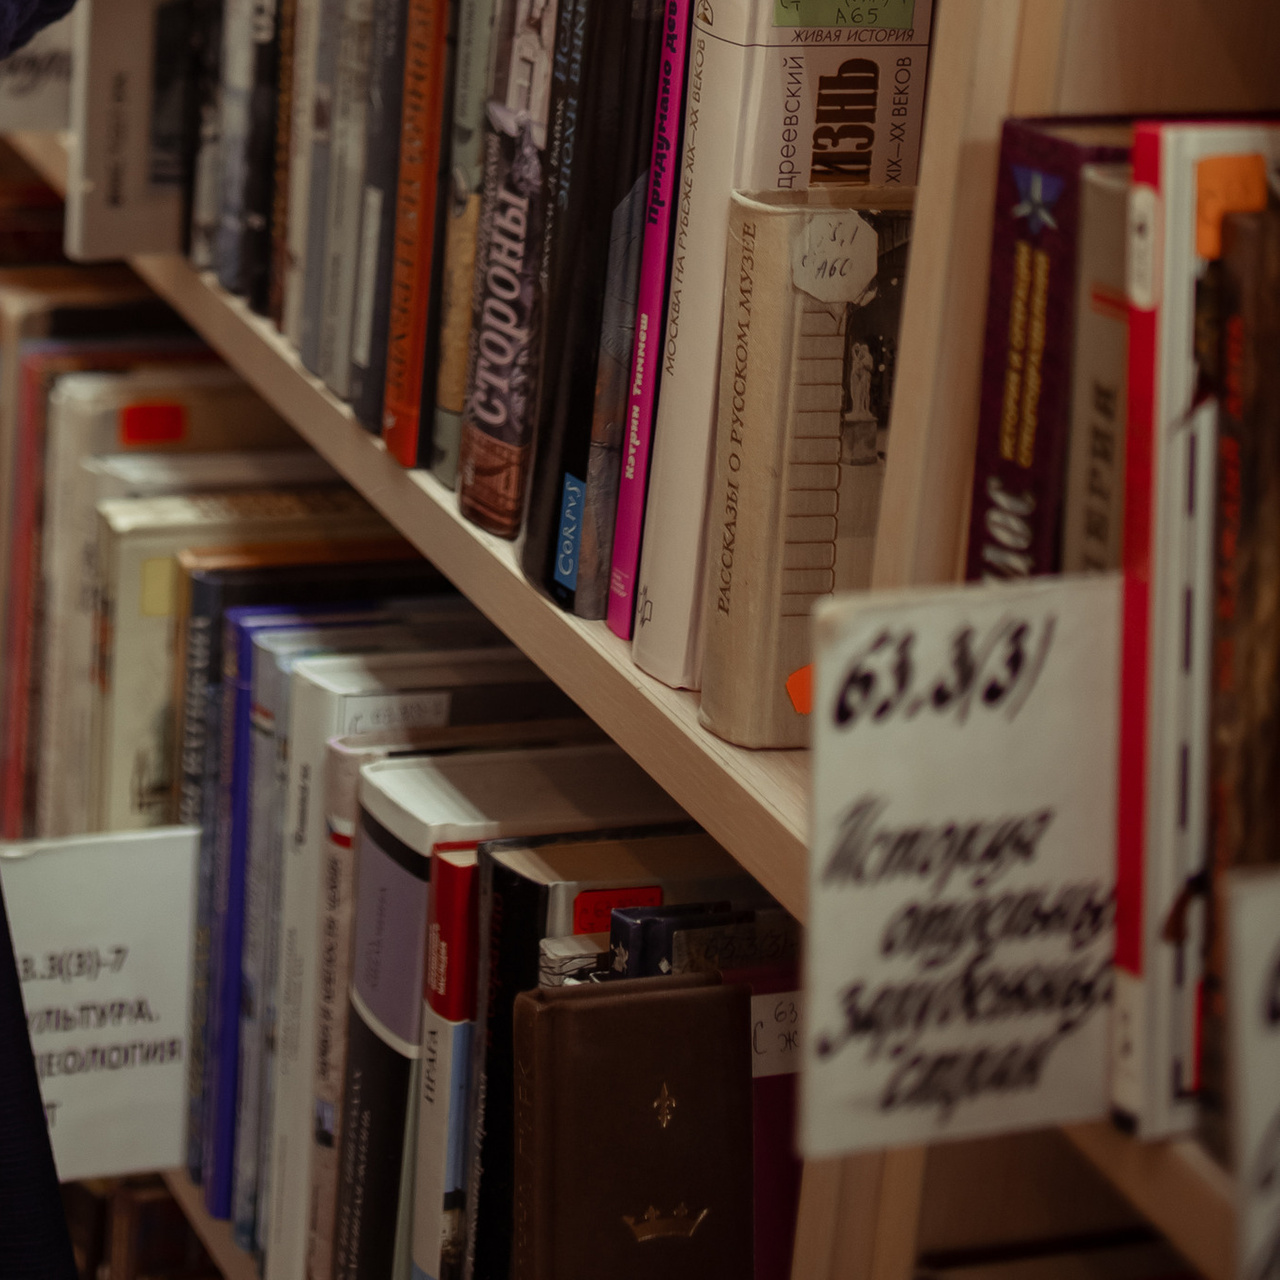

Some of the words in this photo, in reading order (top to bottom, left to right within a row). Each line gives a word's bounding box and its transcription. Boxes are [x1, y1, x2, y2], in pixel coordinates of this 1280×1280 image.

[693, 37, 708, 104] ВЕКОВ
[791, 29, 842, 43] ЖИВАЯ
[847, 28, 915, 43] ИСТОРИЯ
[777, 56, 805, 189] ДРЕЕВСКИЙ
[892, 56, 912, 118] ВЕКОВ
[676, 178, 695, 254] РУБЕЖЕ
[673, 253, 686, 286] НА
[738, 221, 759, 326] МУЗЕЕ
[665, 289, 683, 377] МОСКВА
[729, 330, 752, 449] РУССКОМ
[728, 452, 742, 474] О
[717, 483, 743, 618] РАССКАЗЫ
